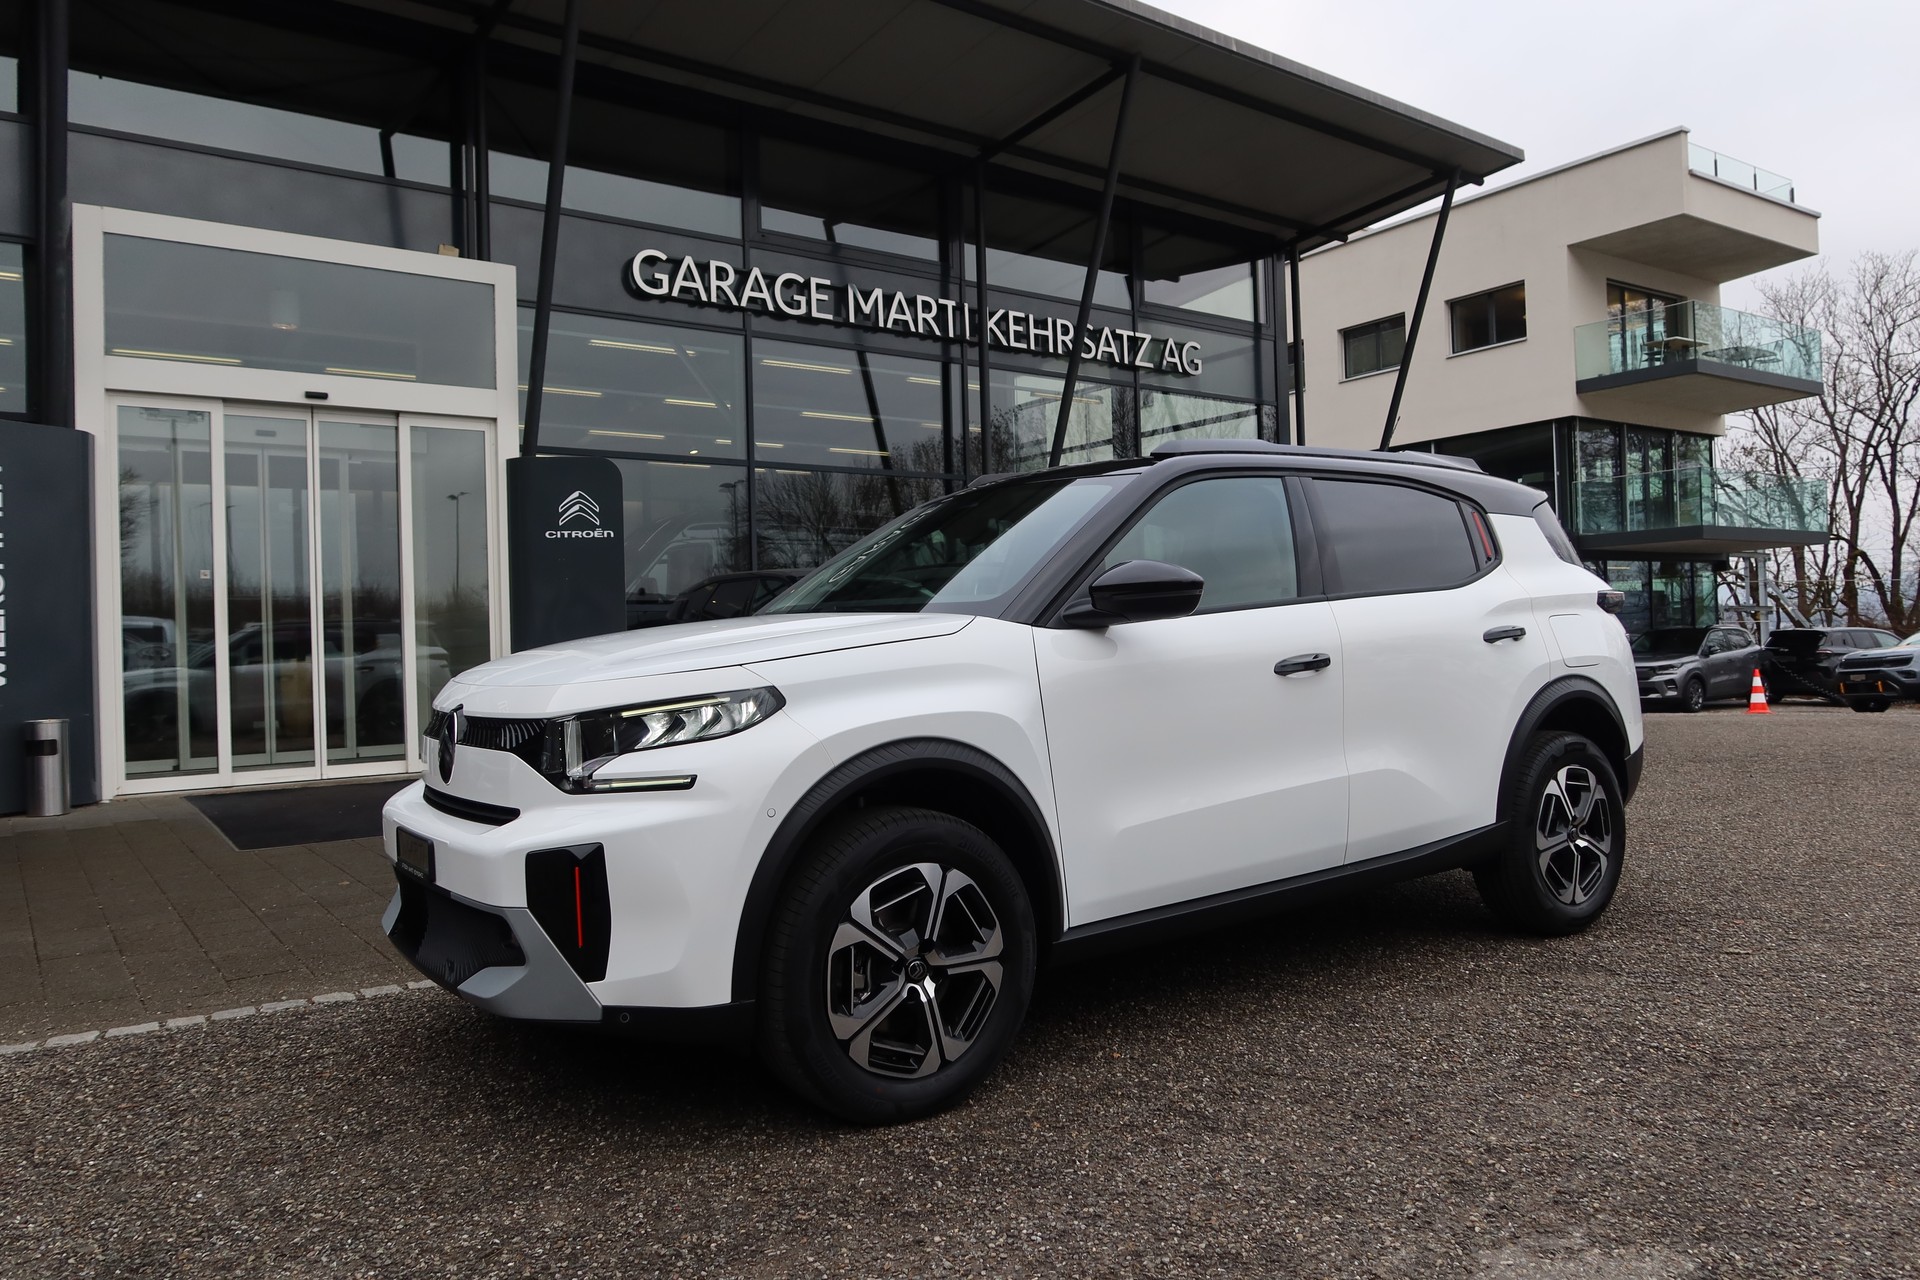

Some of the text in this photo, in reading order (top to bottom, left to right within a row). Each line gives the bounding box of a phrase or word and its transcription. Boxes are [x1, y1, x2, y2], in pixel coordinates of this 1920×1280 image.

[632, 248, 1203, 376] GARAGE MARTI KEHRSATZ AG
[545, 528, 614, 539] CITROËN
[957, 836, 1020, 901] BRIDGESTONE
